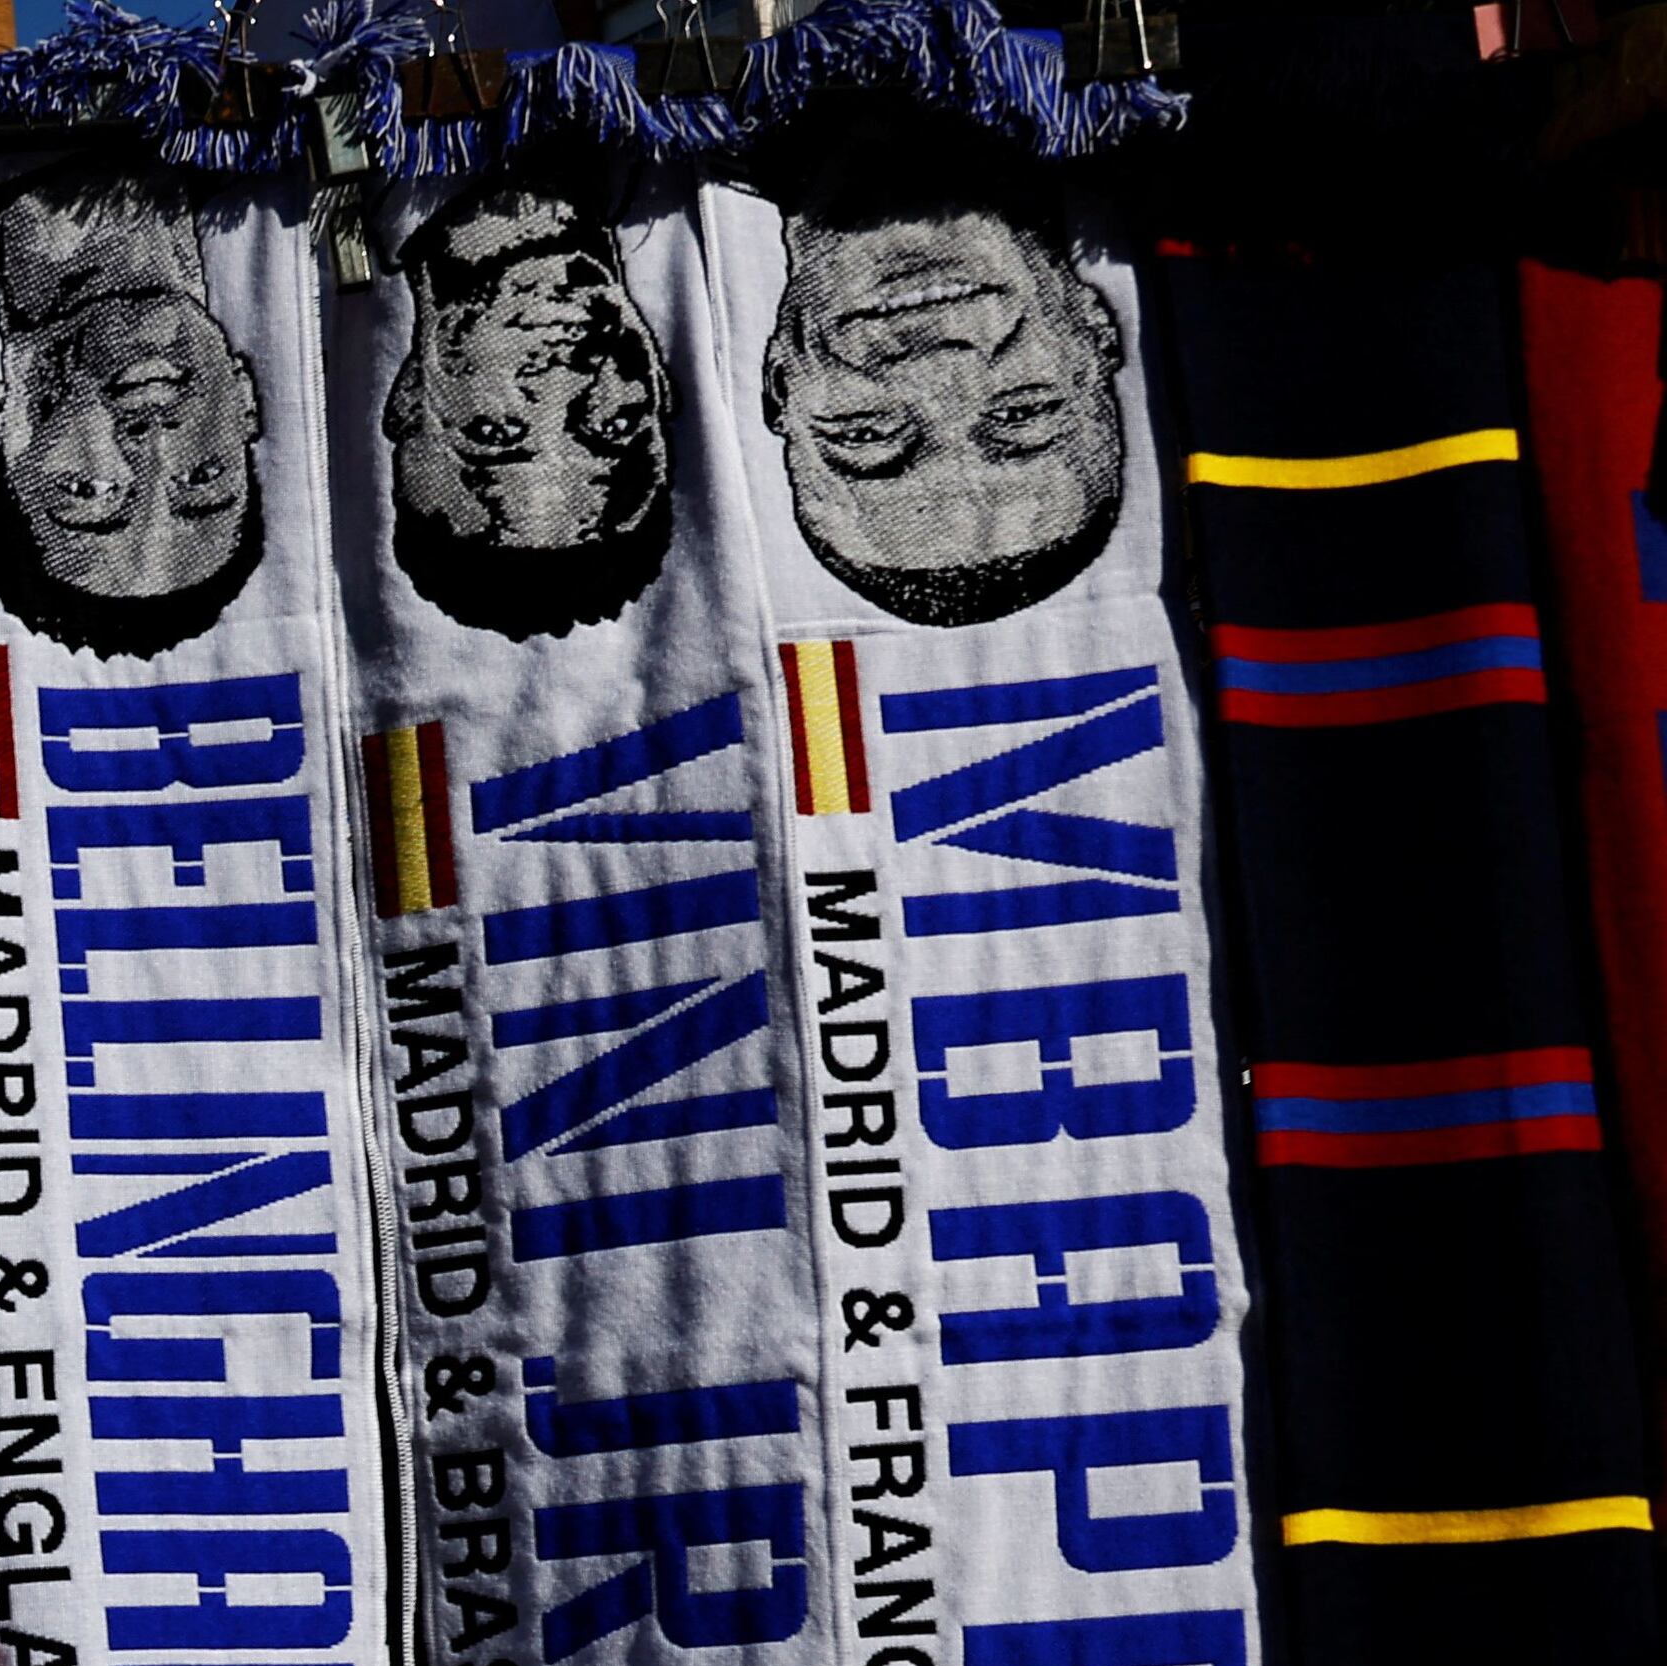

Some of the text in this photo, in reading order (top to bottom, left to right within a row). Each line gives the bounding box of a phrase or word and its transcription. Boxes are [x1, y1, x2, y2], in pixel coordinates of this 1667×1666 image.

[383, 941, 491, 1318] MADRID
[471, 692, 787, 1264] VINI
[806, 868, 905, 1248] MADRID
[423, 1354, 497, 1421] &
[842, 1288, 915, 1352] &
